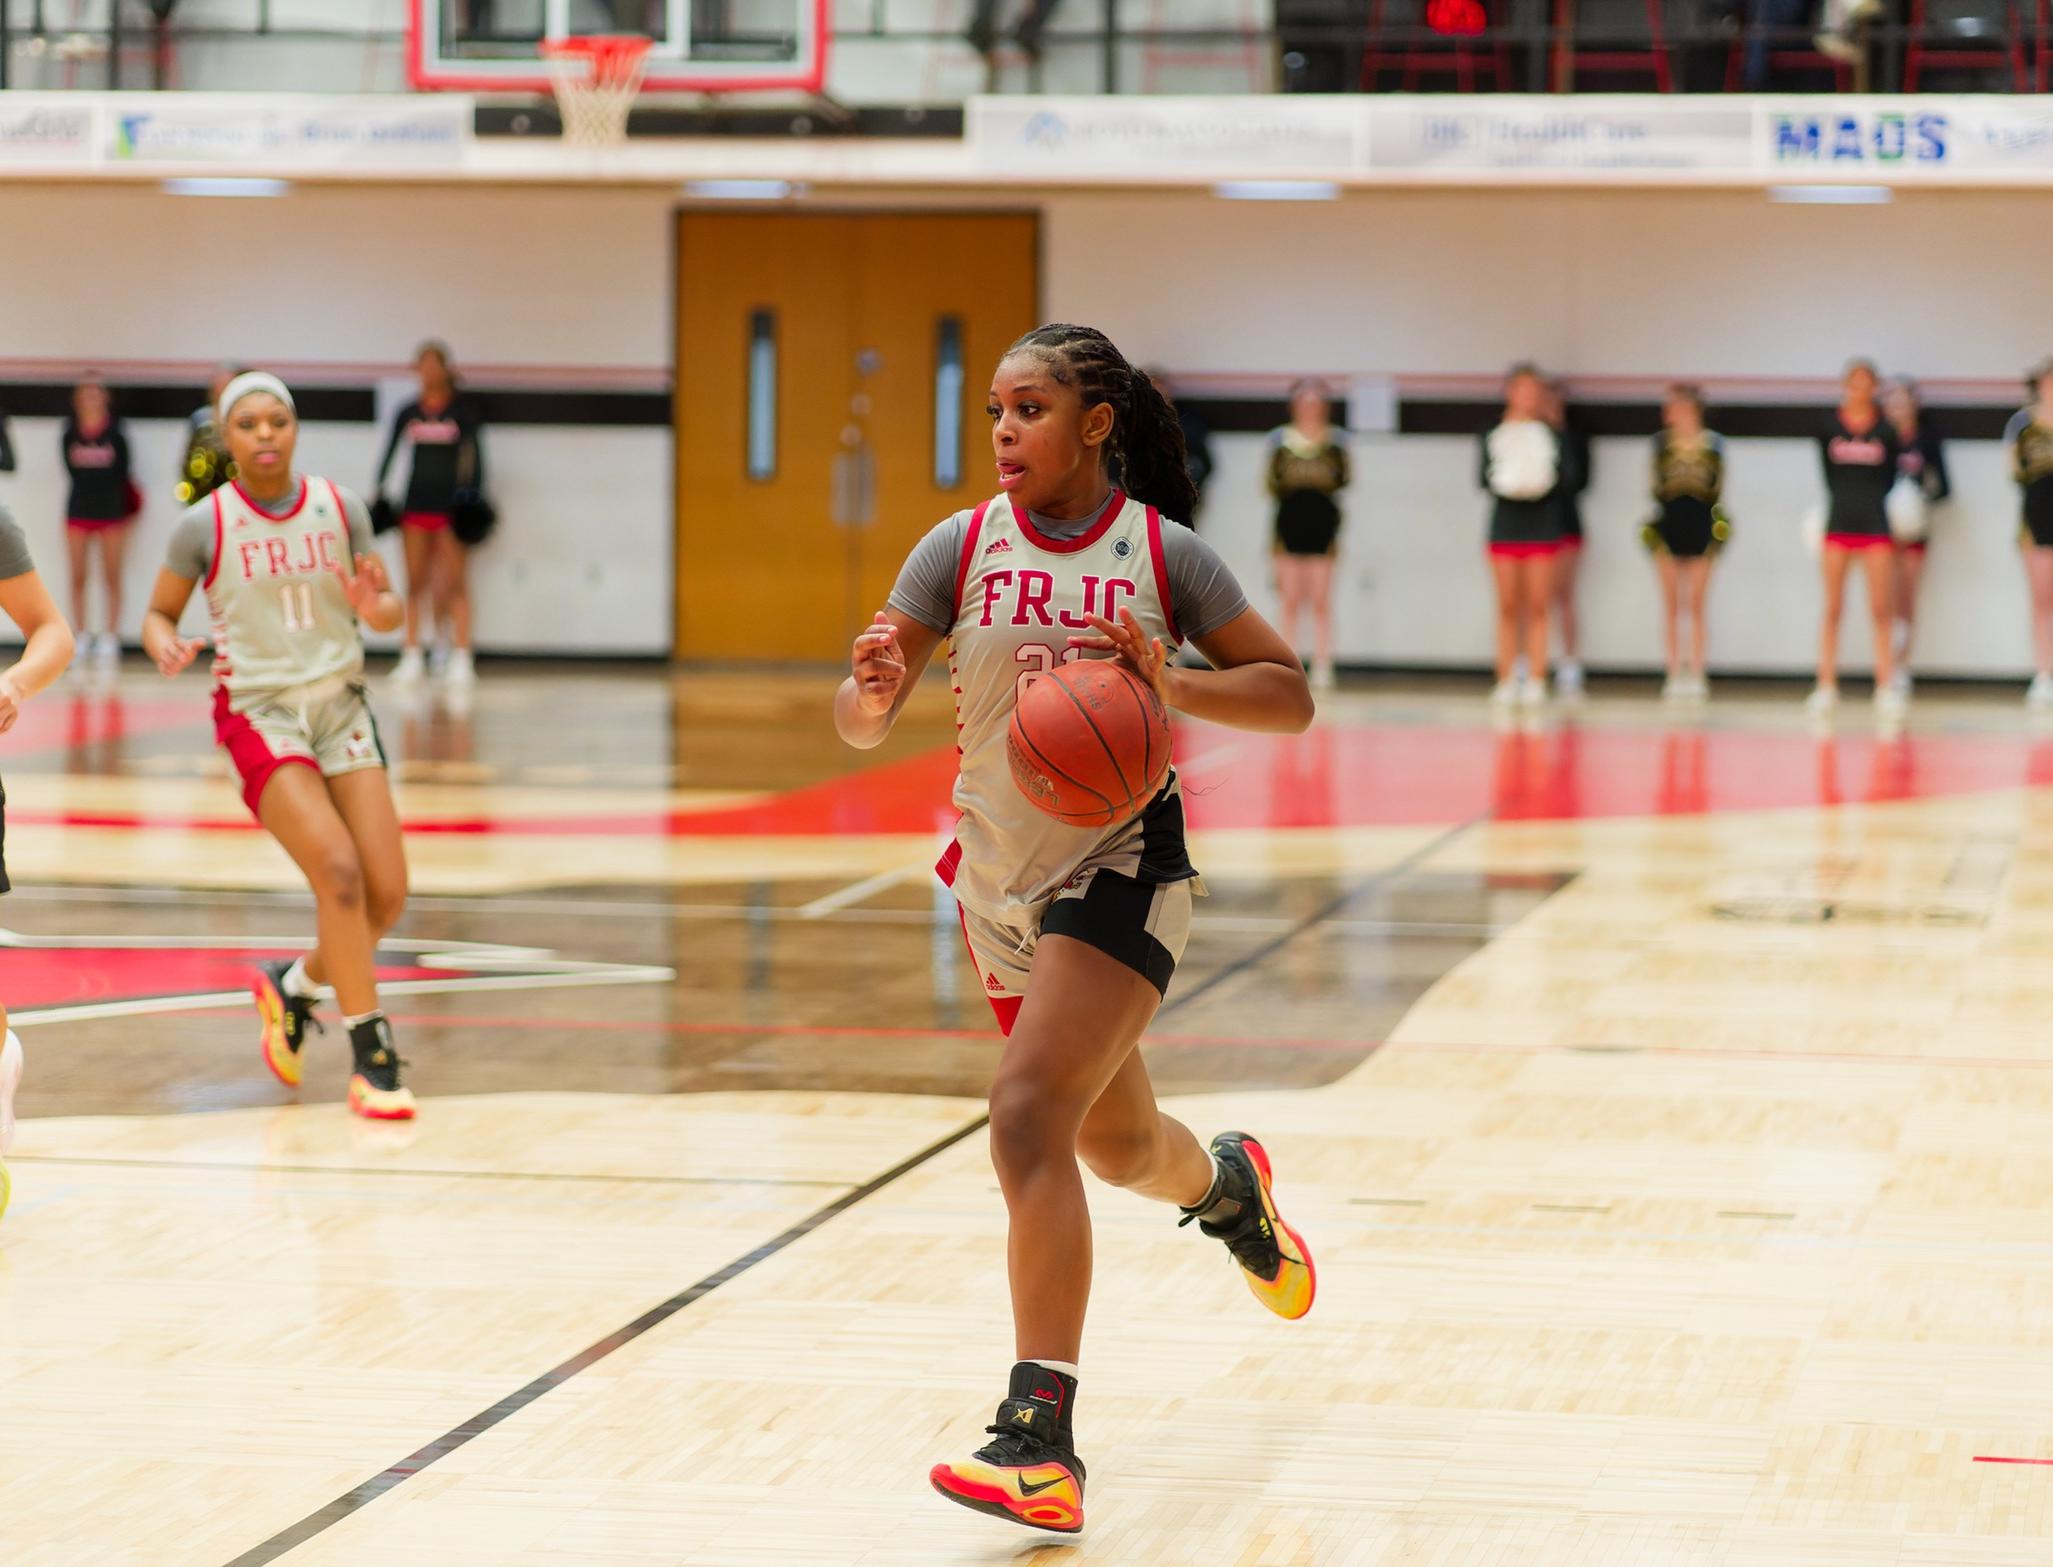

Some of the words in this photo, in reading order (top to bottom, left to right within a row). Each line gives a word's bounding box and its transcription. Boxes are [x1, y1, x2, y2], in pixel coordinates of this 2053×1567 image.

[239, 531, 337, 582] FRJC
[280, 582, 316, 633] 11
[978, 569, 1137, 630] FRJC
